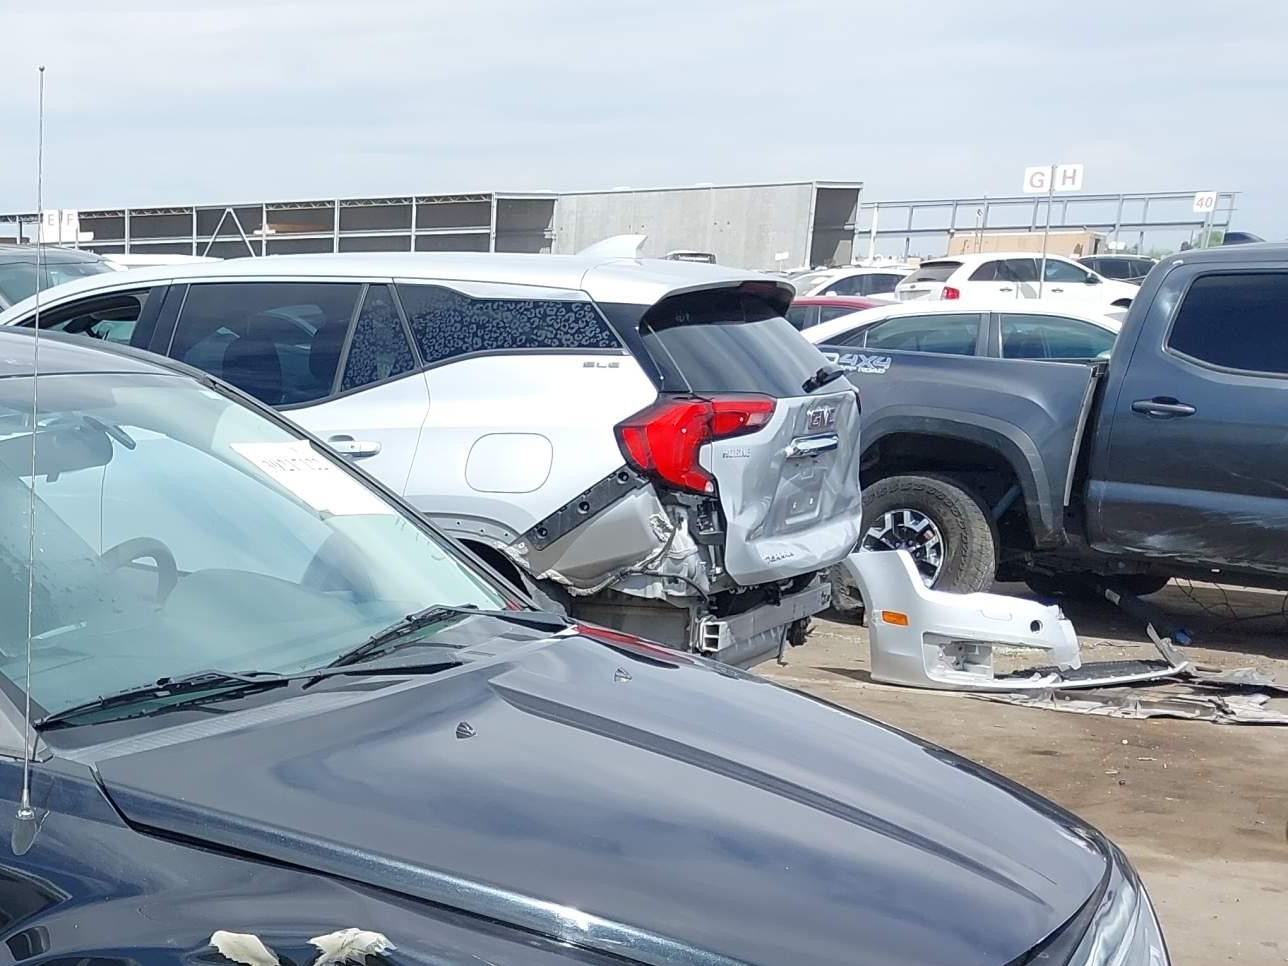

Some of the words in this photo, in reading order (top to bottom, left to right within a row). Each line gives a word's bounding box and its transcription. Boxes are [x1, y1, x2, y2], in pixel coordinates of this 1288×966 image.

[1029, 171, 1046, 188] G
[1061, 168, 1077, 186] H
[1195, 196, 1214, 209] 40
[47, 213, 55, 226] E
